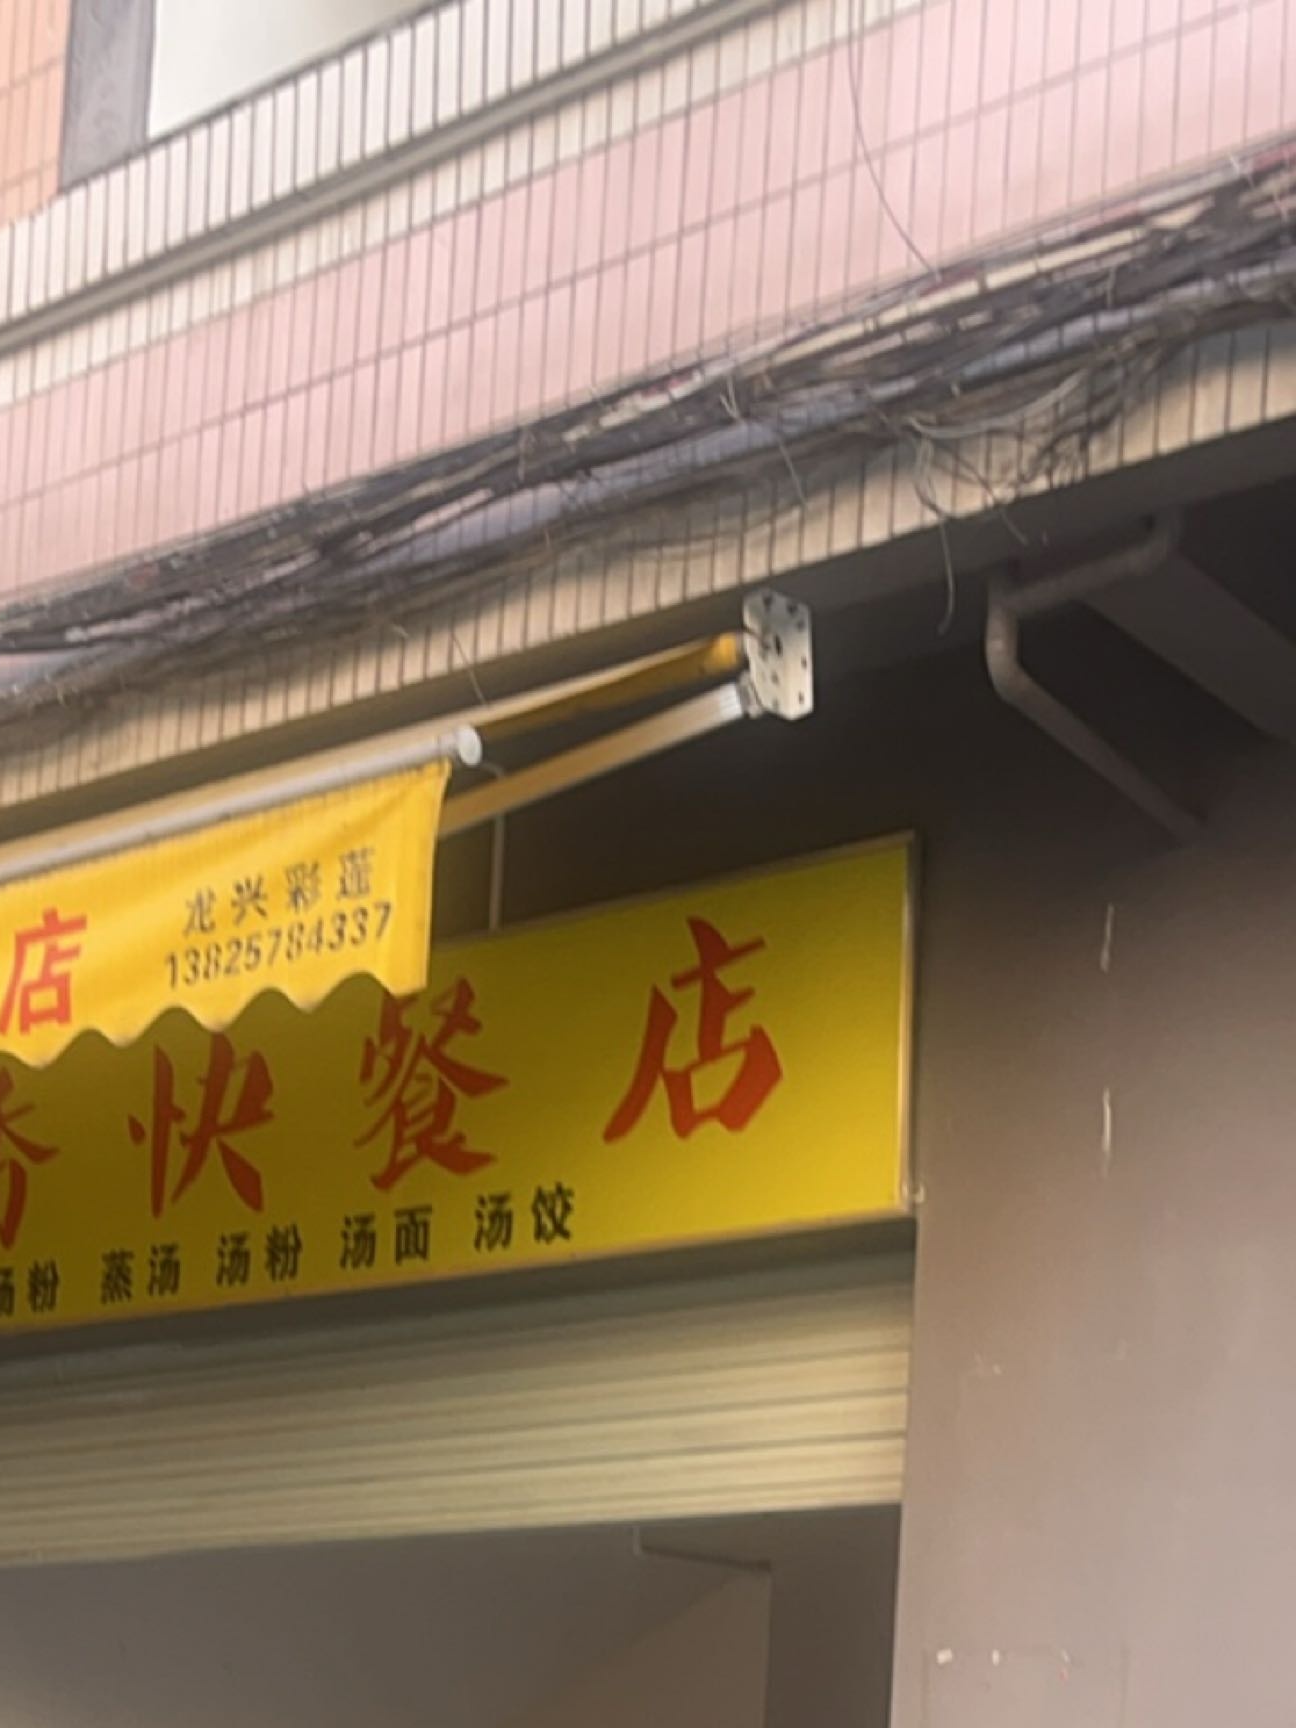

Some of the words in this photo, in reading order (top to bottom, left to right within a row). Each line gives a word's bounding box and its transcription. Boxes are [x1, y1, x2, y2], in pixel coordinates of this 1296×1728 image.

[165, 902, 392, 990] 13825784337
[215, 1225, 303, 1286] 汤粉
[338, 1205, 433, 1271] 汤面
[474, 1182, 574, 1252] 汤饺
